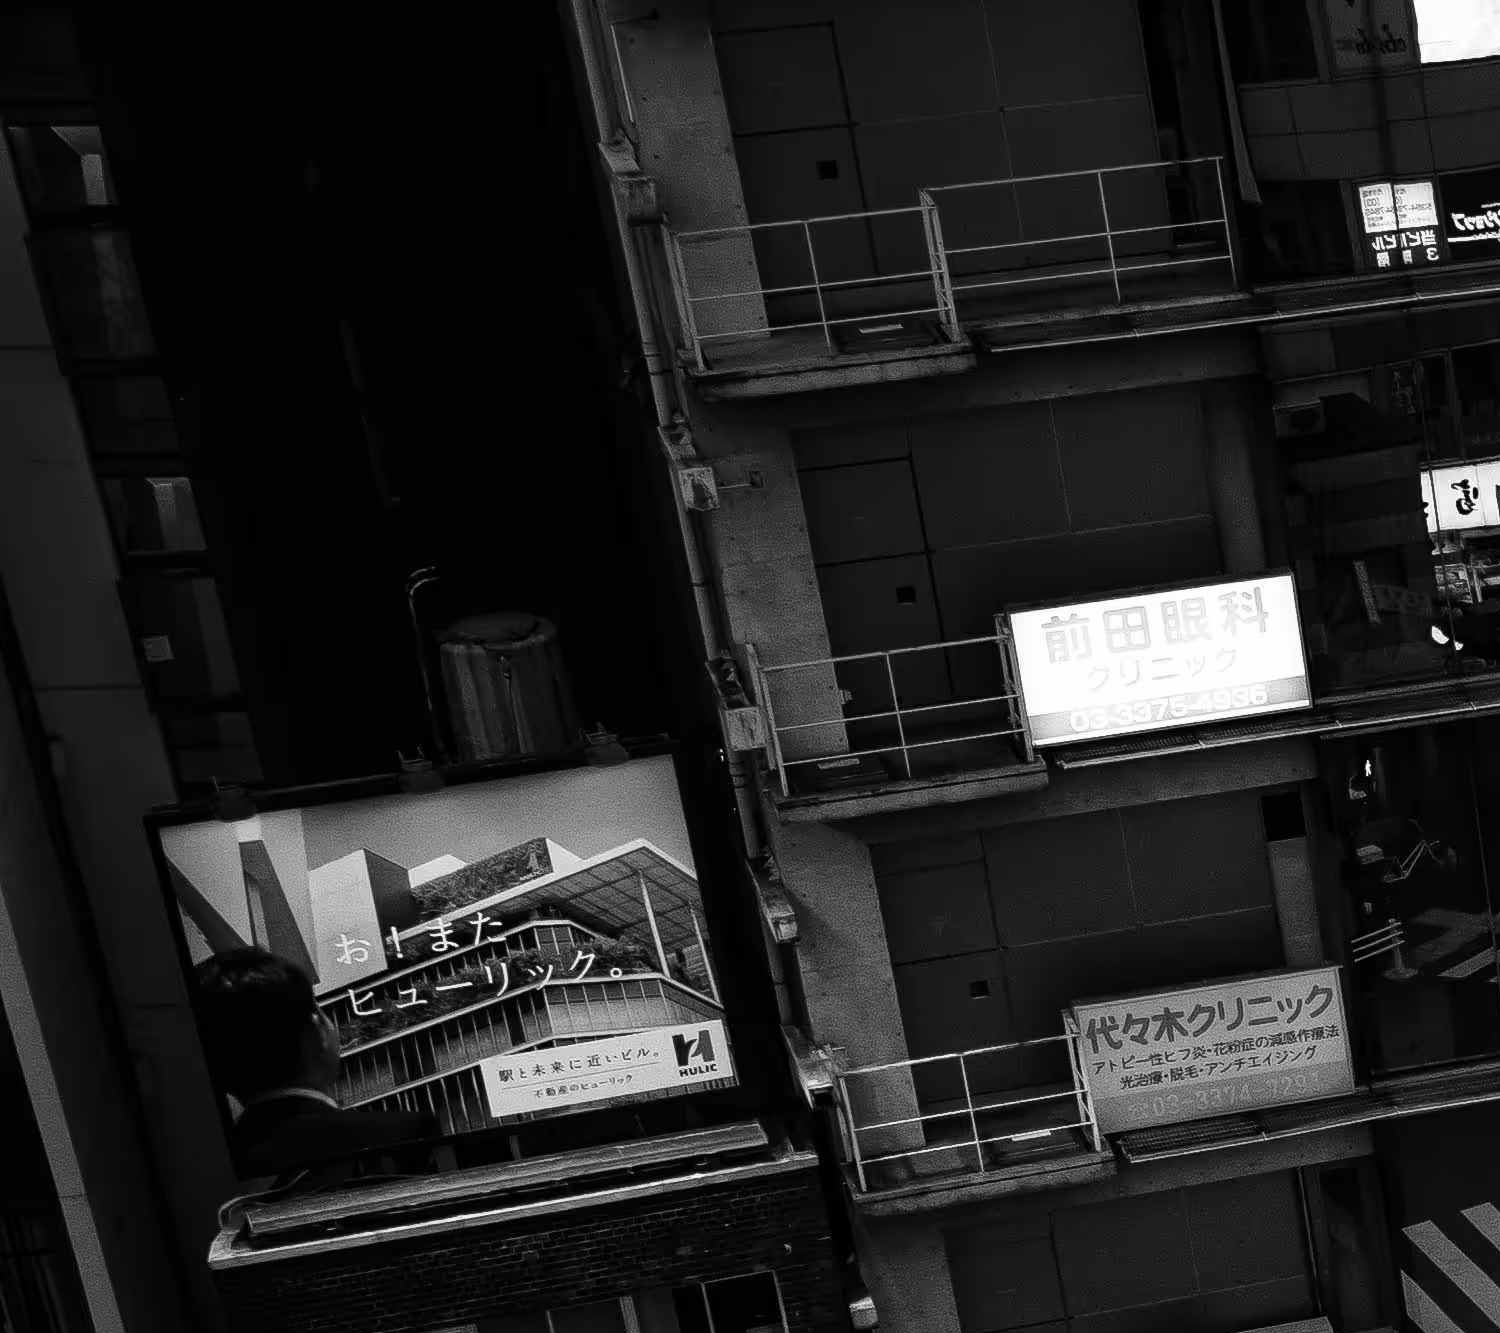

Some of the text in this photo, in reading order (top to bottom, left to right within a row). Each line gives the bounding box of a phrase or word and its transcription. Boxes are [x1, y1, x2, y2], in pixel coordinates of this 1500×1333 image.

[1041, 587, 1269, 664] 前田眼科
[1089, 648, 1237, 693] クリニック
[348, 950, 623, 1017] ヒューリック。
[1086, 984, 1333, 1054] 代々木クリニック
[498, 1047, 661, 1082] 駅と未来に近いビル。
[679, 1063, 718, 1078] HULIC
